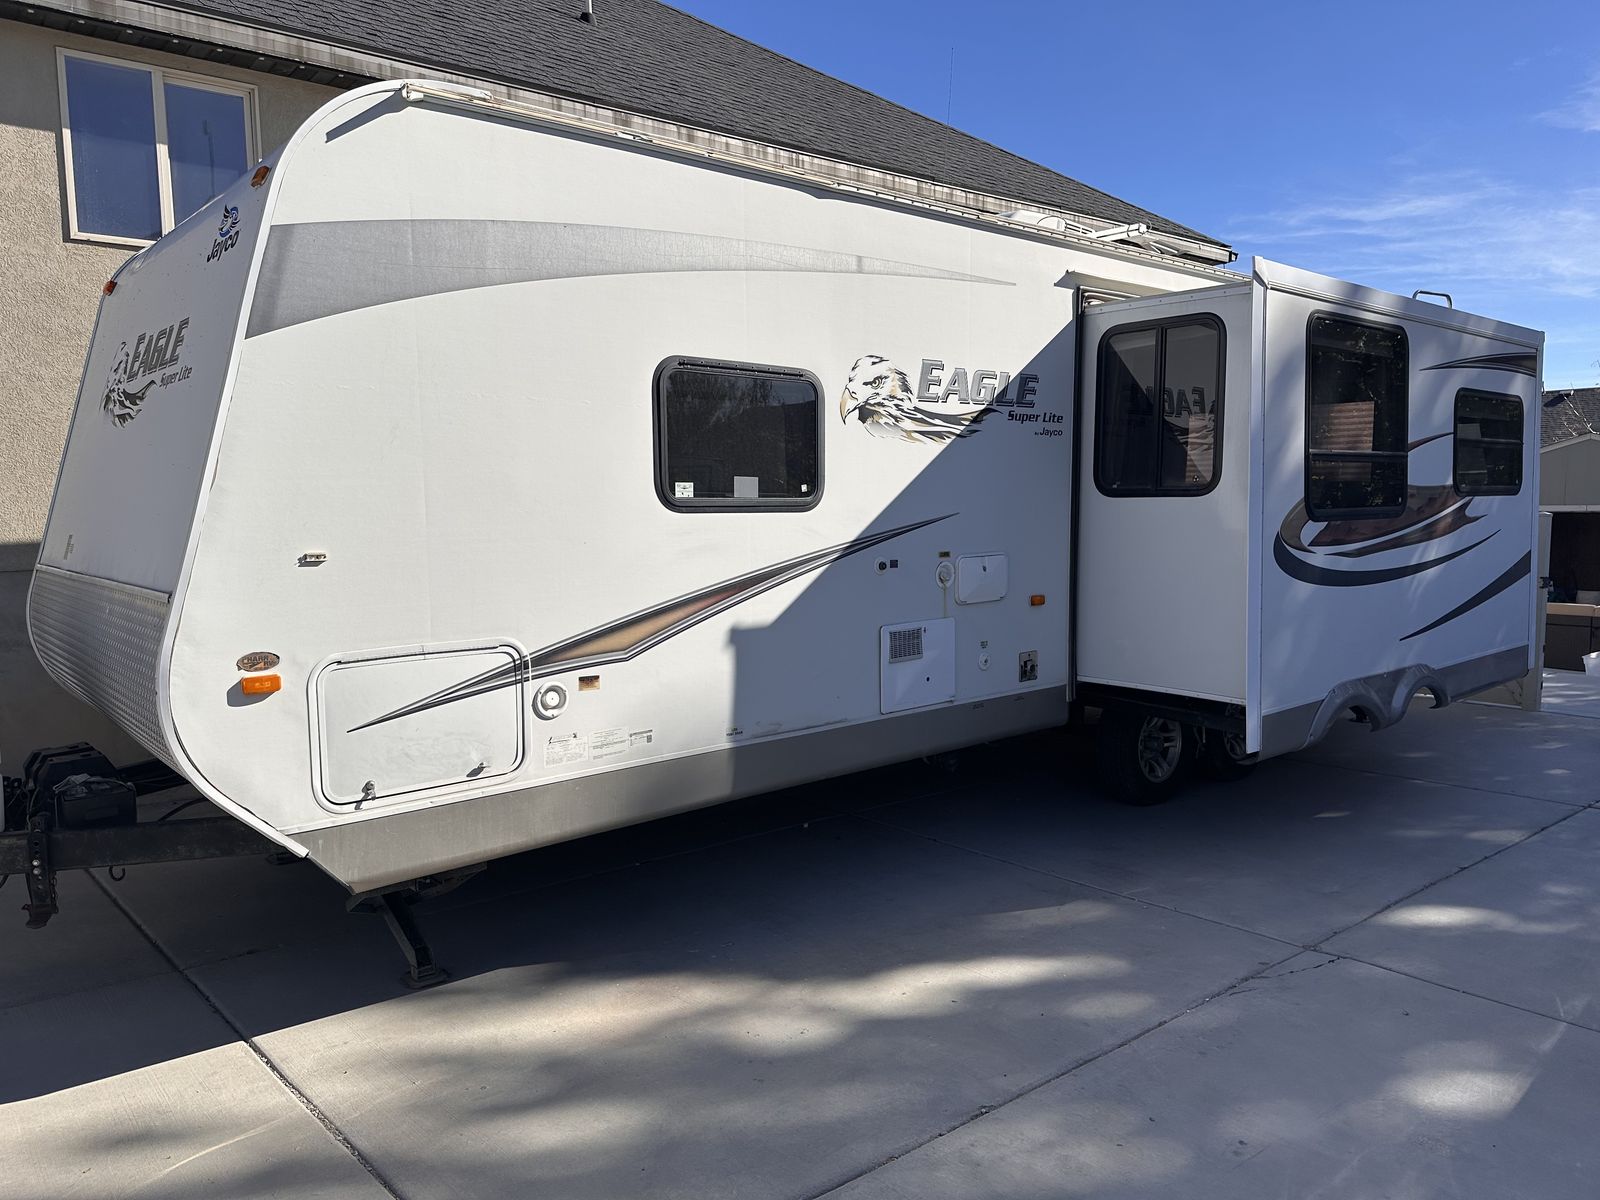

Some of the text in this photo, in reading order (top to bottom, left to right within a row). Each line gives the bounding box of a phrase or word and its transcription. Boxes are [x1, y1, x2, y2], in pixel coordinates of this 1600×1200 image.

[207, 230, 240, 263] Jayco
[127, 316, 190, 383] EAGLE
[159, 365, 193, 389] Super Lite
[916, 358, 1039, 409] EAGLE
[1007, 410, 1064, 425] Super Lite
[1039, 427, 1063, 438] Jayco
